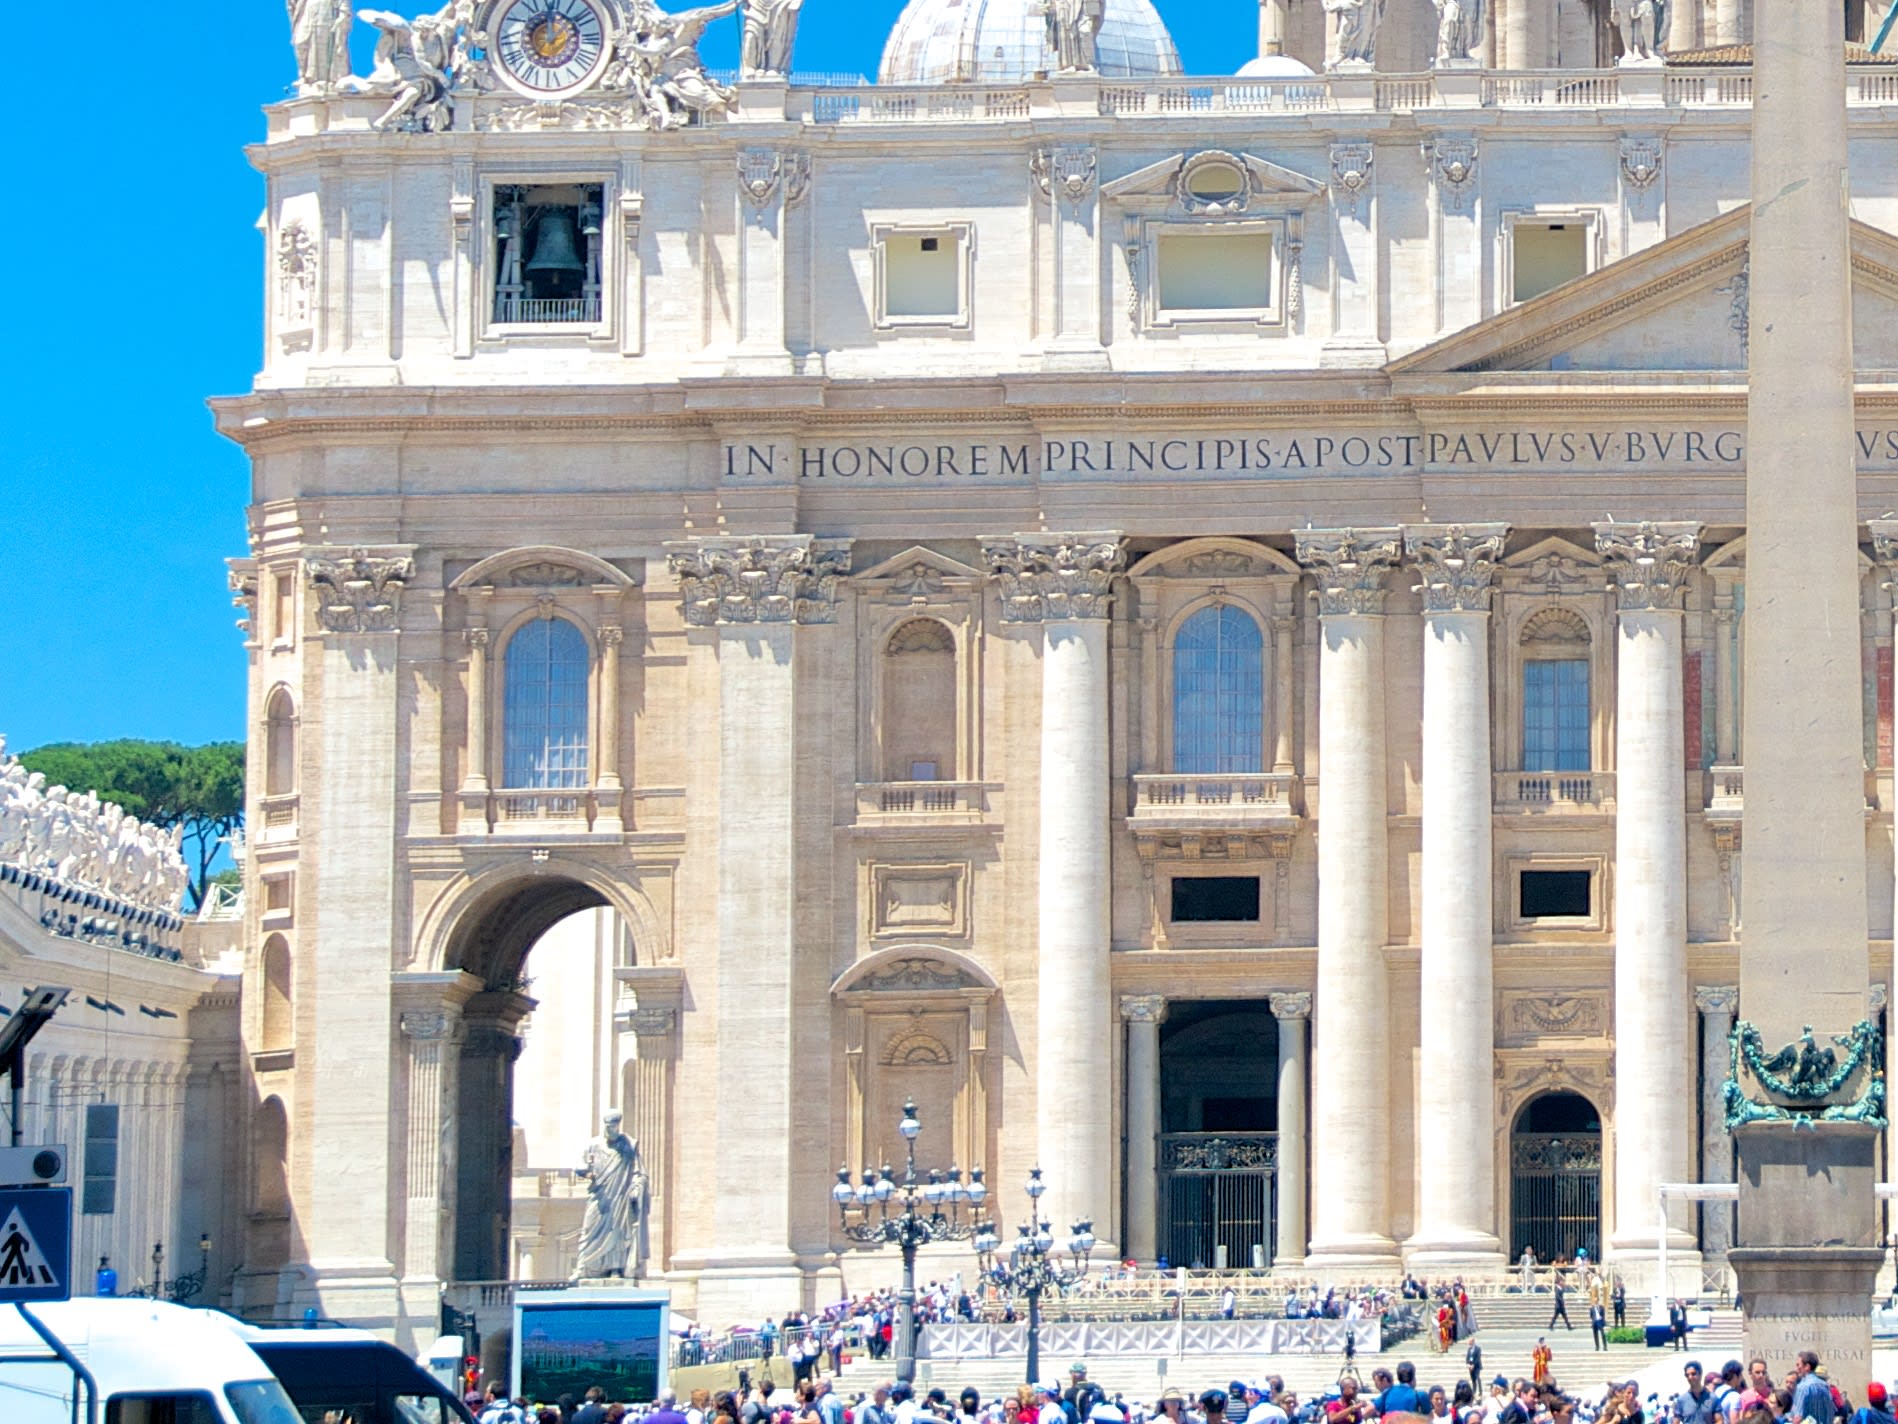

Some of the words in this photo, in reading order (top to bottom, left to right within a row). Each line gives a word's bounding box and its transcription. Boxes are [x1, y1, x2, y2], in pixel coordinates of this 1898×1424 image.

[726, 444, 776, 476] IN
[799, 444, 1031, 478] HONOREM
[1044, 439, 1272, 474] PRINCIPIS
[1281, 435, 1421, 468] APOST
[1426, 431, 1577, 464] PAVLVS
[1585, 431, 1610, 463] V
